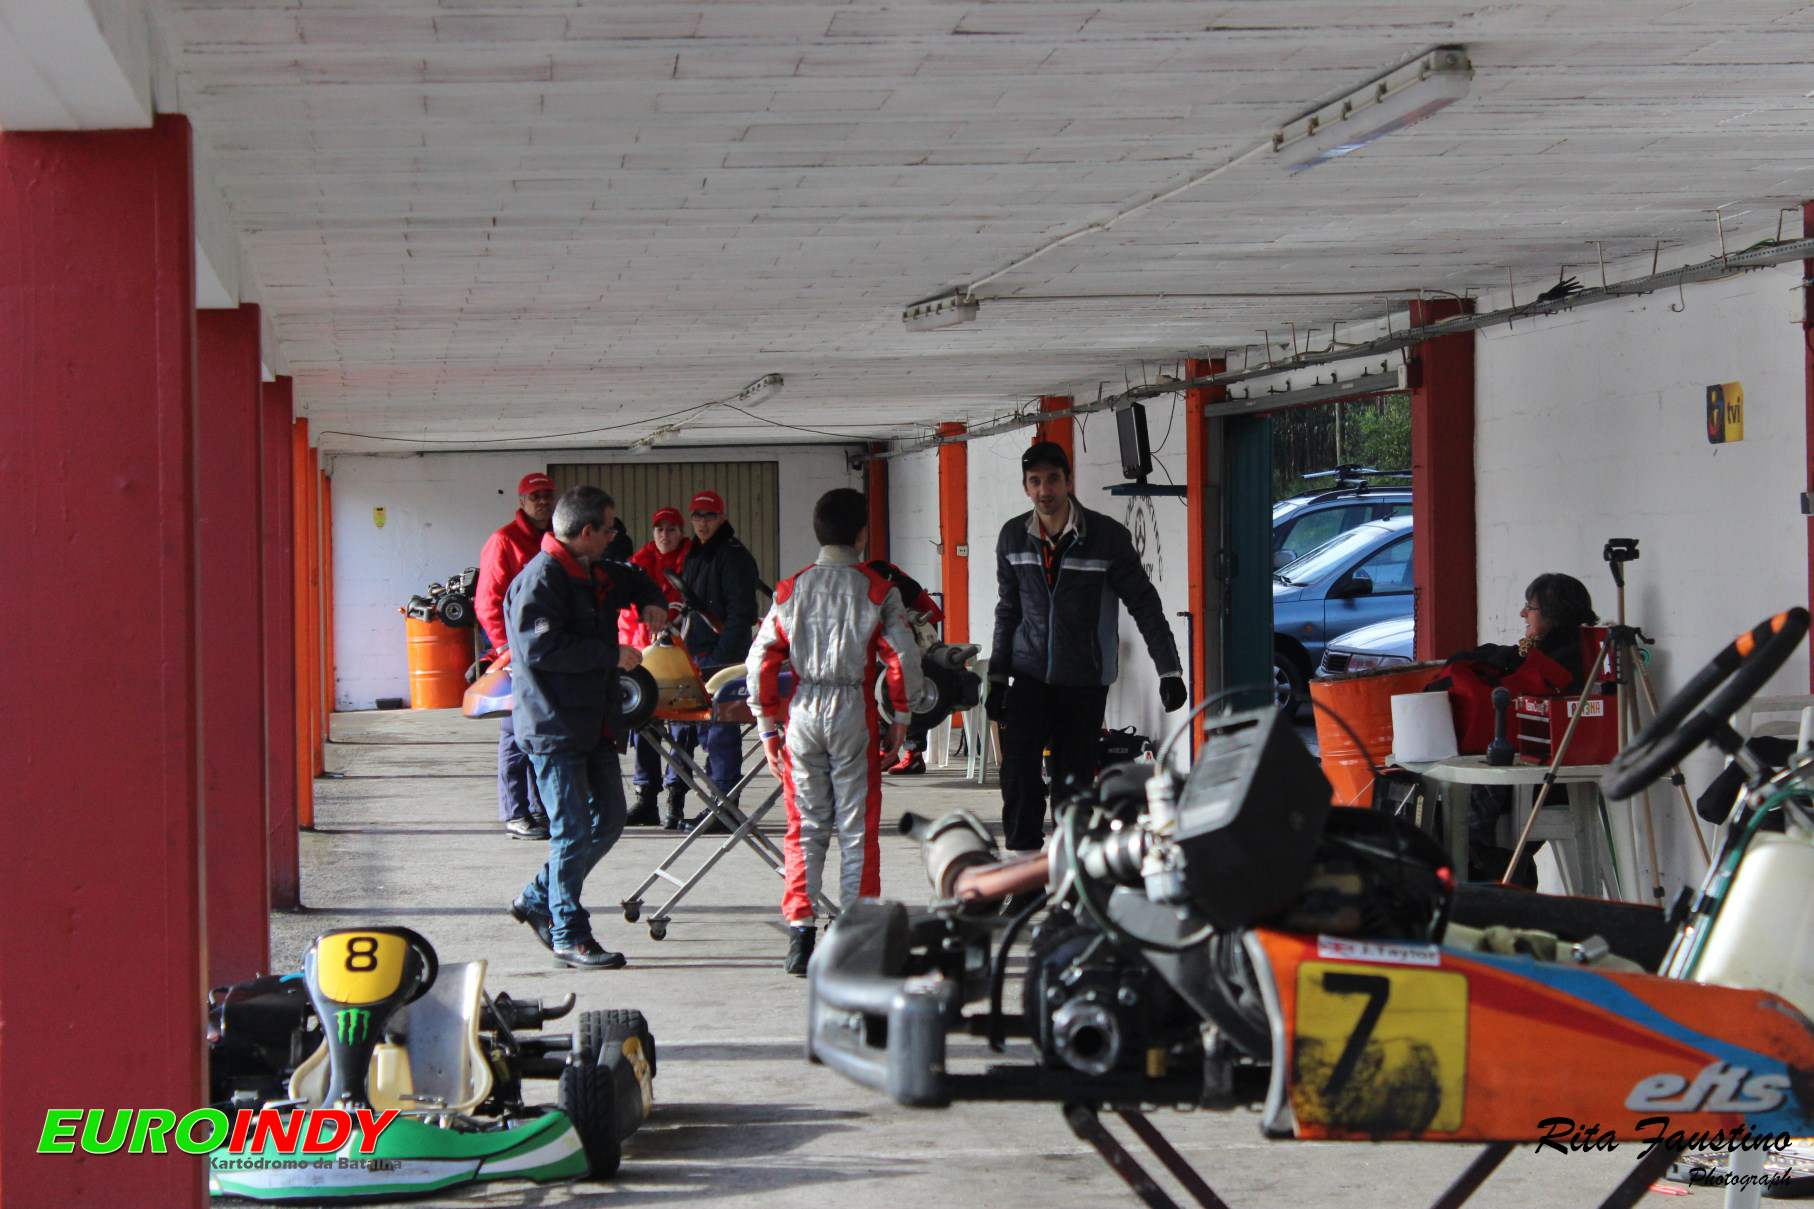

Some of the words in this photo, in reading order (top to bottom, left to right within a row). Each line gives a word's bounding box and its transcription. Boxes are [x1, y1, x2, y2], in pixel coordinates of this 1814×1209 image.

[1727, 396, 1741, 425] tvi
[345, 936, 379, 972] 8
[1320, 971, 1390, 1098] 7
